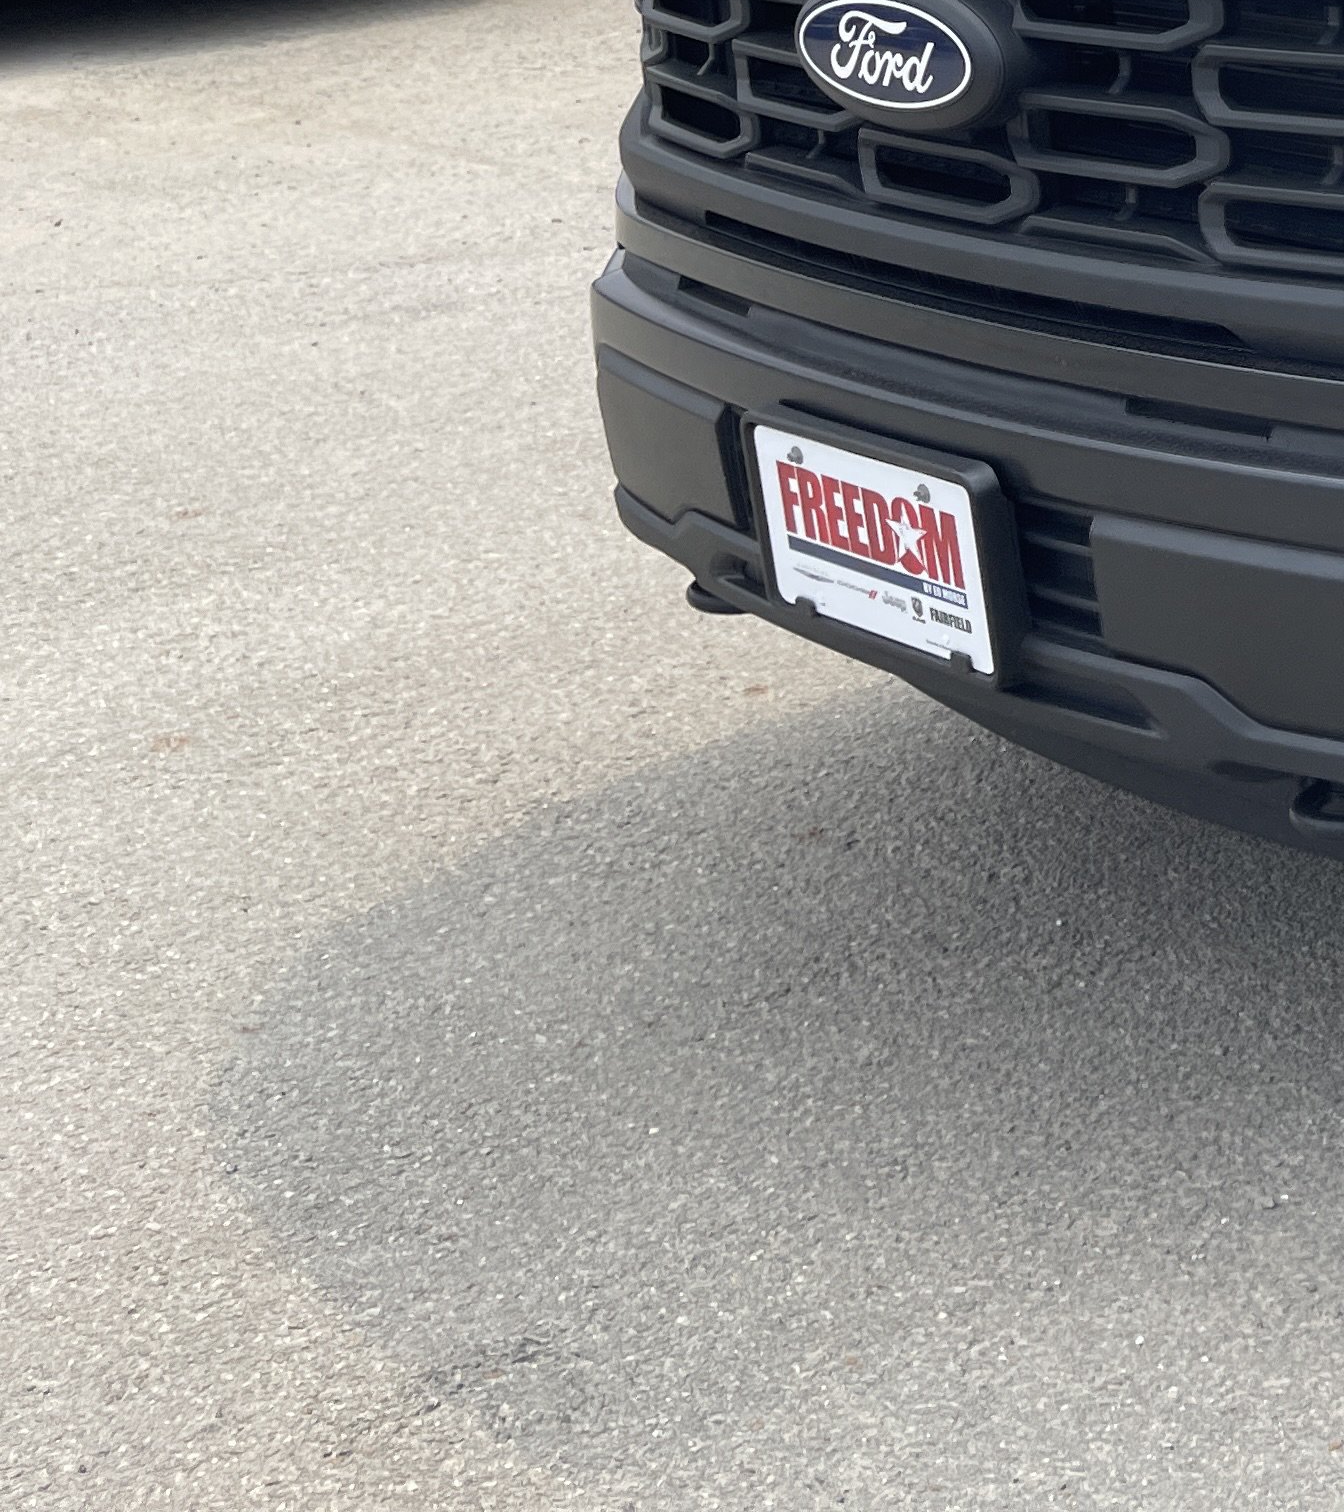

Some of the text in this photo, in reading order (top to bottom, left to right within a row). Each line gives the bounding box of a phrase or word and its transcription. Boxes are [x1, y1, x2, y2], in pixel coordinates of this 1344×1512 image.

[830, 10, 935, 94] Ford
[776, 460, 966, 590] FREEDOM
[929, 607, 973, 634] FAIRFIELD
